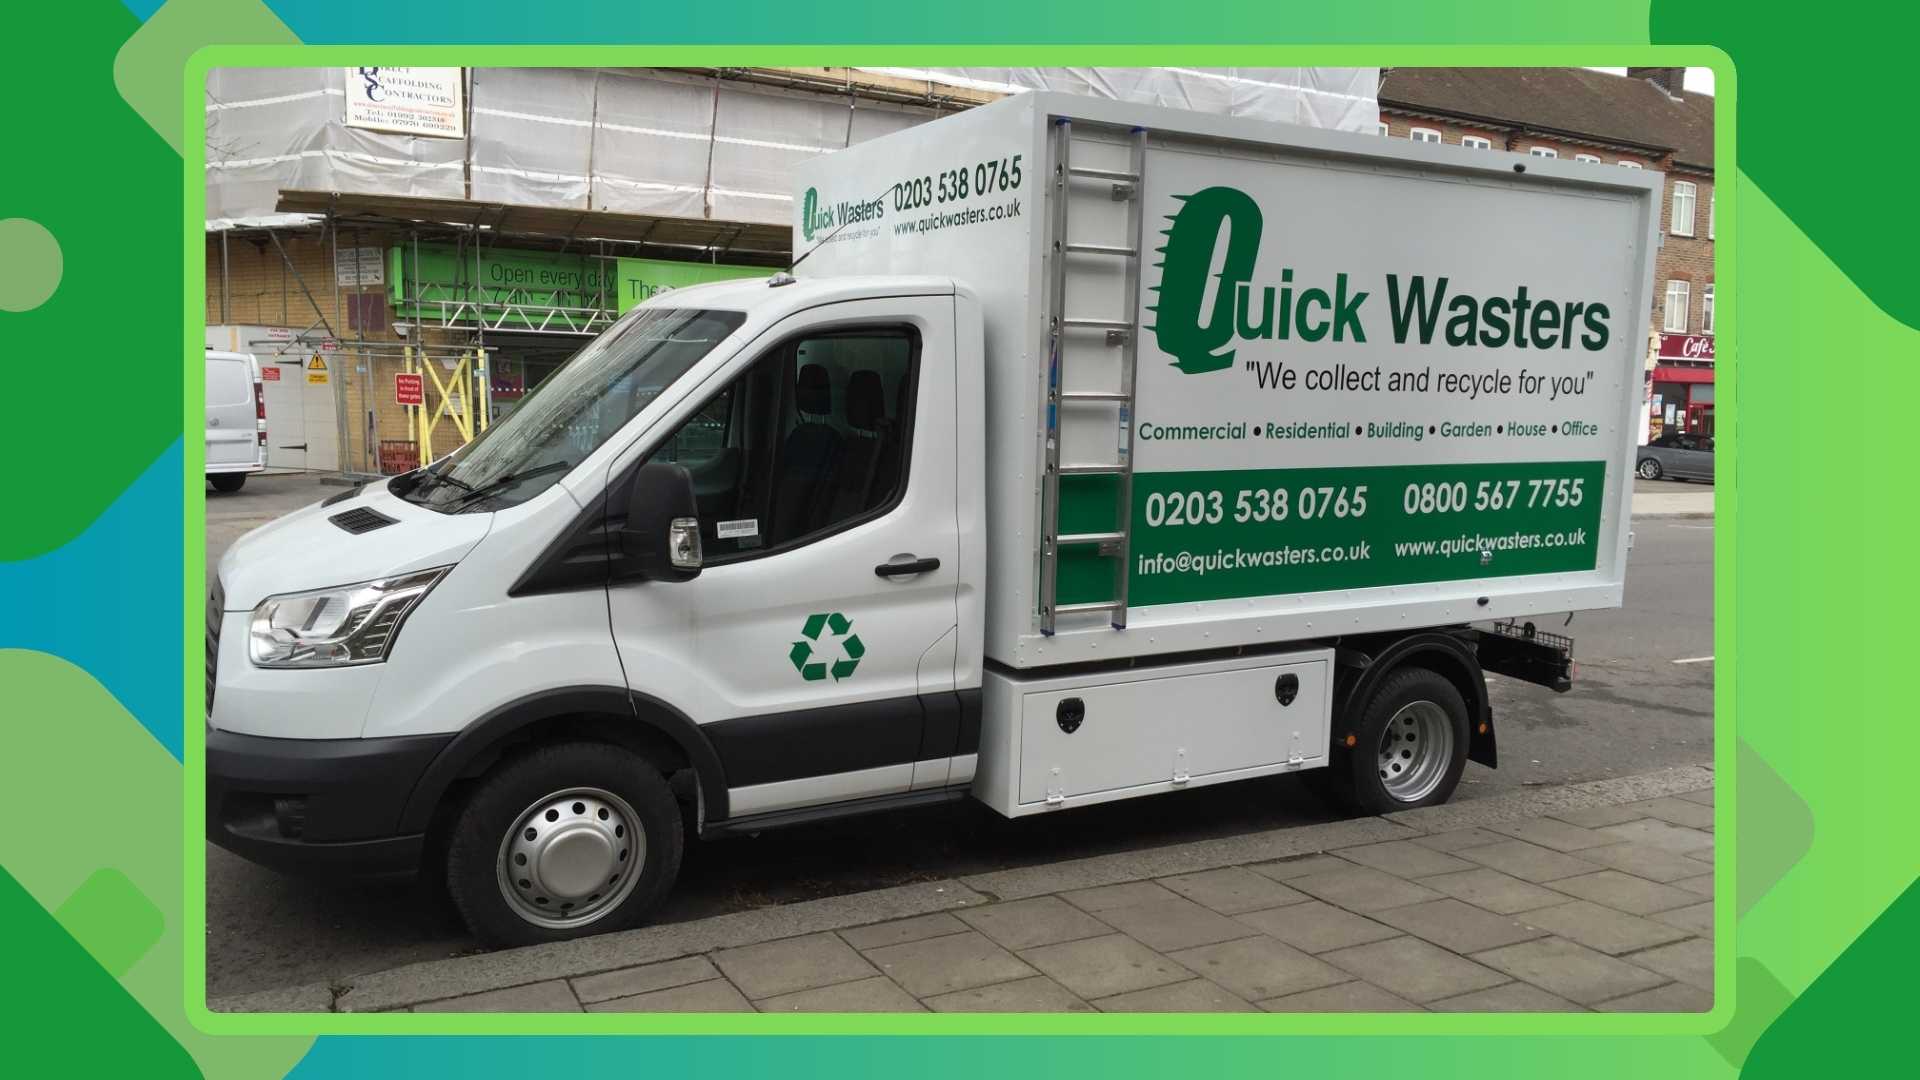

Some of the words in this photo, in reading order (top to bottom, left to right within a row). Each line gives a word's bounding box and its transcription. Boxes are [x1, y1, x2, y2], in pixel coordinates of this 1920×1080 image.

[365, 83, 453, 104] CONTRACTORS
[894, 176, 932, 212] 0203
[937, 167, 969, 203] 538
[974, 155, 1022, 196] 0765
[803, 187, 835, 241] Quick
[837, 198, 884, 225] Wasters
[894, 198, 1021, 236] www.quickwasters.co.uk
[491, 263, 533, 286] Open
[540, 269, 582, 289] every
[587, 269, 616, 290] day
[1143, 186, 1369, 374] Quick
[1386, 273, 1610, 351] Wasters
[1245, 360, 1296, 390] "We
[1305, 364, 1381, 391] collect
[1388, 367, 1429, 392] and
[1437, 368, 1511, 400] recycle
[1517, 369, 1545, 394] for
[1550, 370, 1594, 400] you"
[1139, 422, 1246, 441] Commercial
[1265, 422, 1350, 440] Residential
[1367, 421, 1424, 441] Building
[1440, 421, 1492, 438] Garden
[1507, 420, 1546, 438] House
[1561, 420, 1598, 436] Office
[1145, 490, 1223, 527] 0203
[1233, 488, 1289, 524] 538
[1298, 485, 1367, 520] 0765
[1403, 482, 1467, 515] 0800
[1474, 480, 1520, 511] 567
[1527, 478, 1584, 509] 7755
[1138, 540, 1370, 575] info@quickwasters.co.uk
[1394, 528, 1586, 558] www.quickwasters.co.uk
